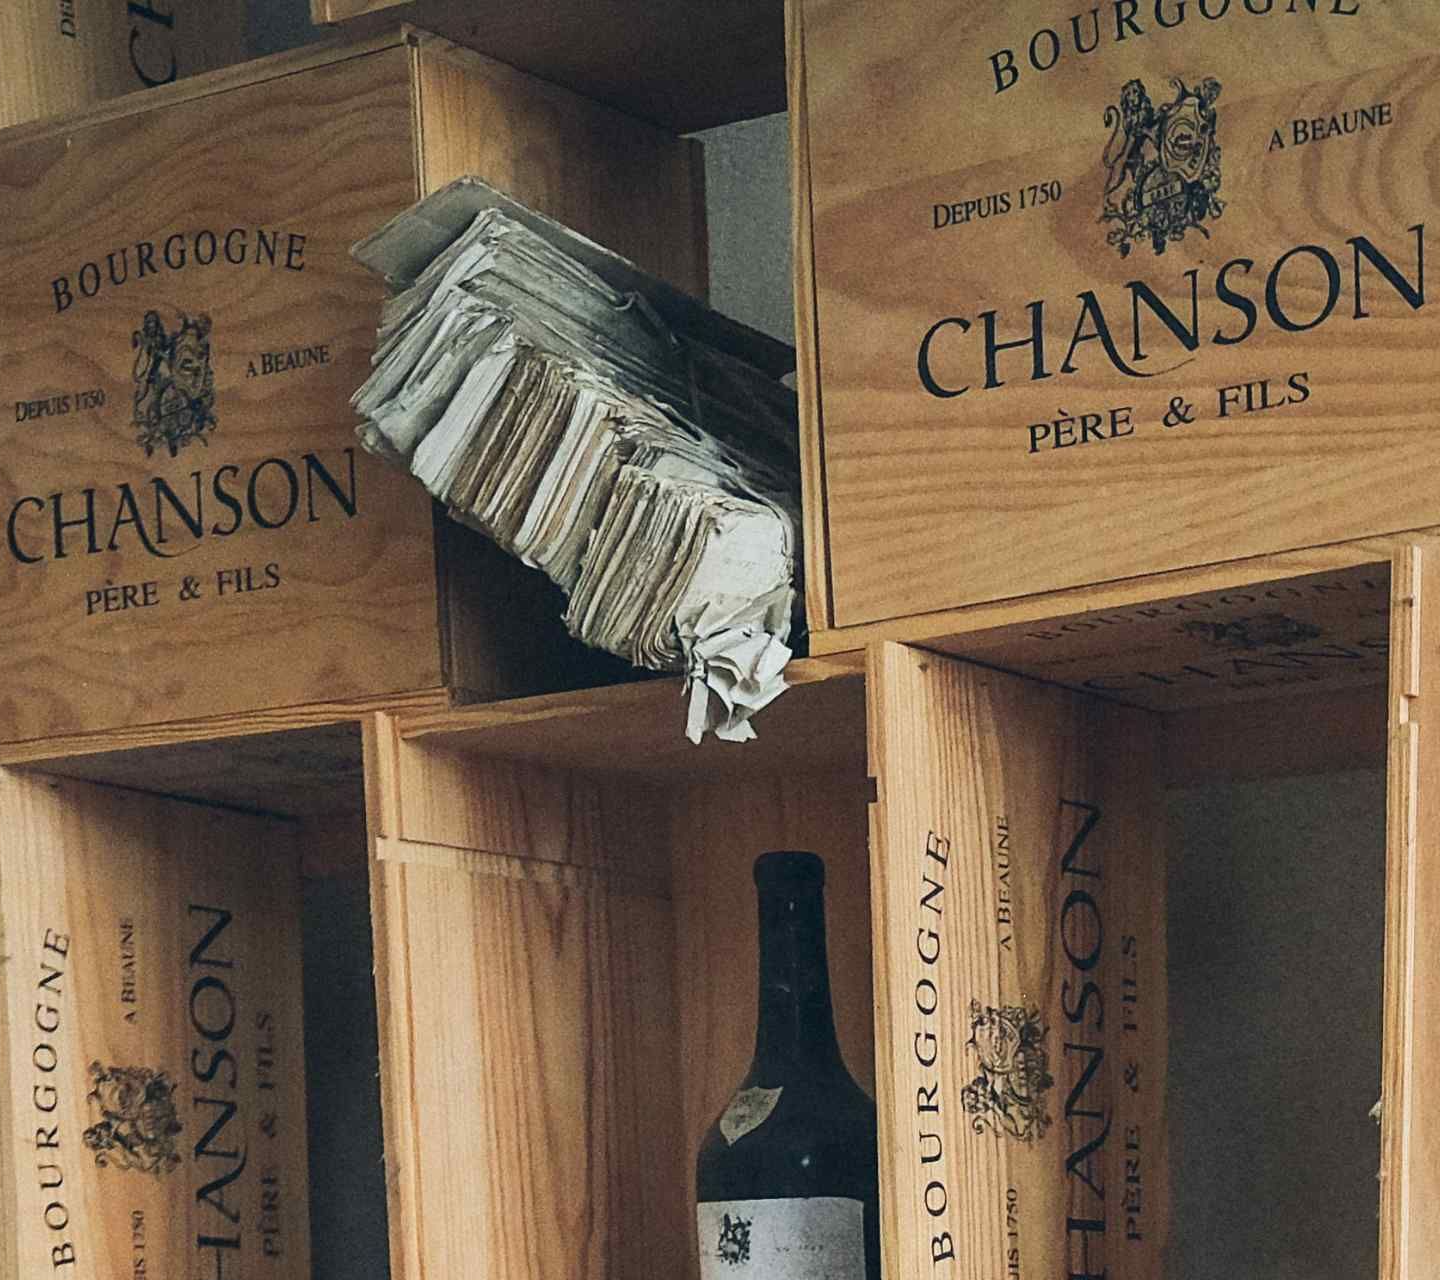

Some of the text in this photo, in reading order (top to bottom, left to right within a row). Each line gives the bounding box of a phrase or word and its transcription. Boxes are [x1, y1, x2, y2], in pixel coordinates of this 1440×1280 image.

[1268, 102, 1394, 151] A BEAUNE
[932, 180, 1063, 230] DEPUIS 1750
[50, 228, 307, 314] BOURGOGNE
[916, 223, 1428, 400] CHANSON
[261, 343, 331, 375] BEAUNE
[15, 390, 106, 423] DEPUIS 1750
[1028, 371, 1310, 453] PÈRE & FILS
[6, 448, 360, 565] CHANSON
[86, 563, 282, 616] PÈRE & FILS
[995, 812, 1012, 925] BEAUNE
[914, 829, 957, 1267] BOURGOGNE
[32, 927, 77, 1271] BOURGOGNE
[1006, 1186, 1019, 1241] 1750
